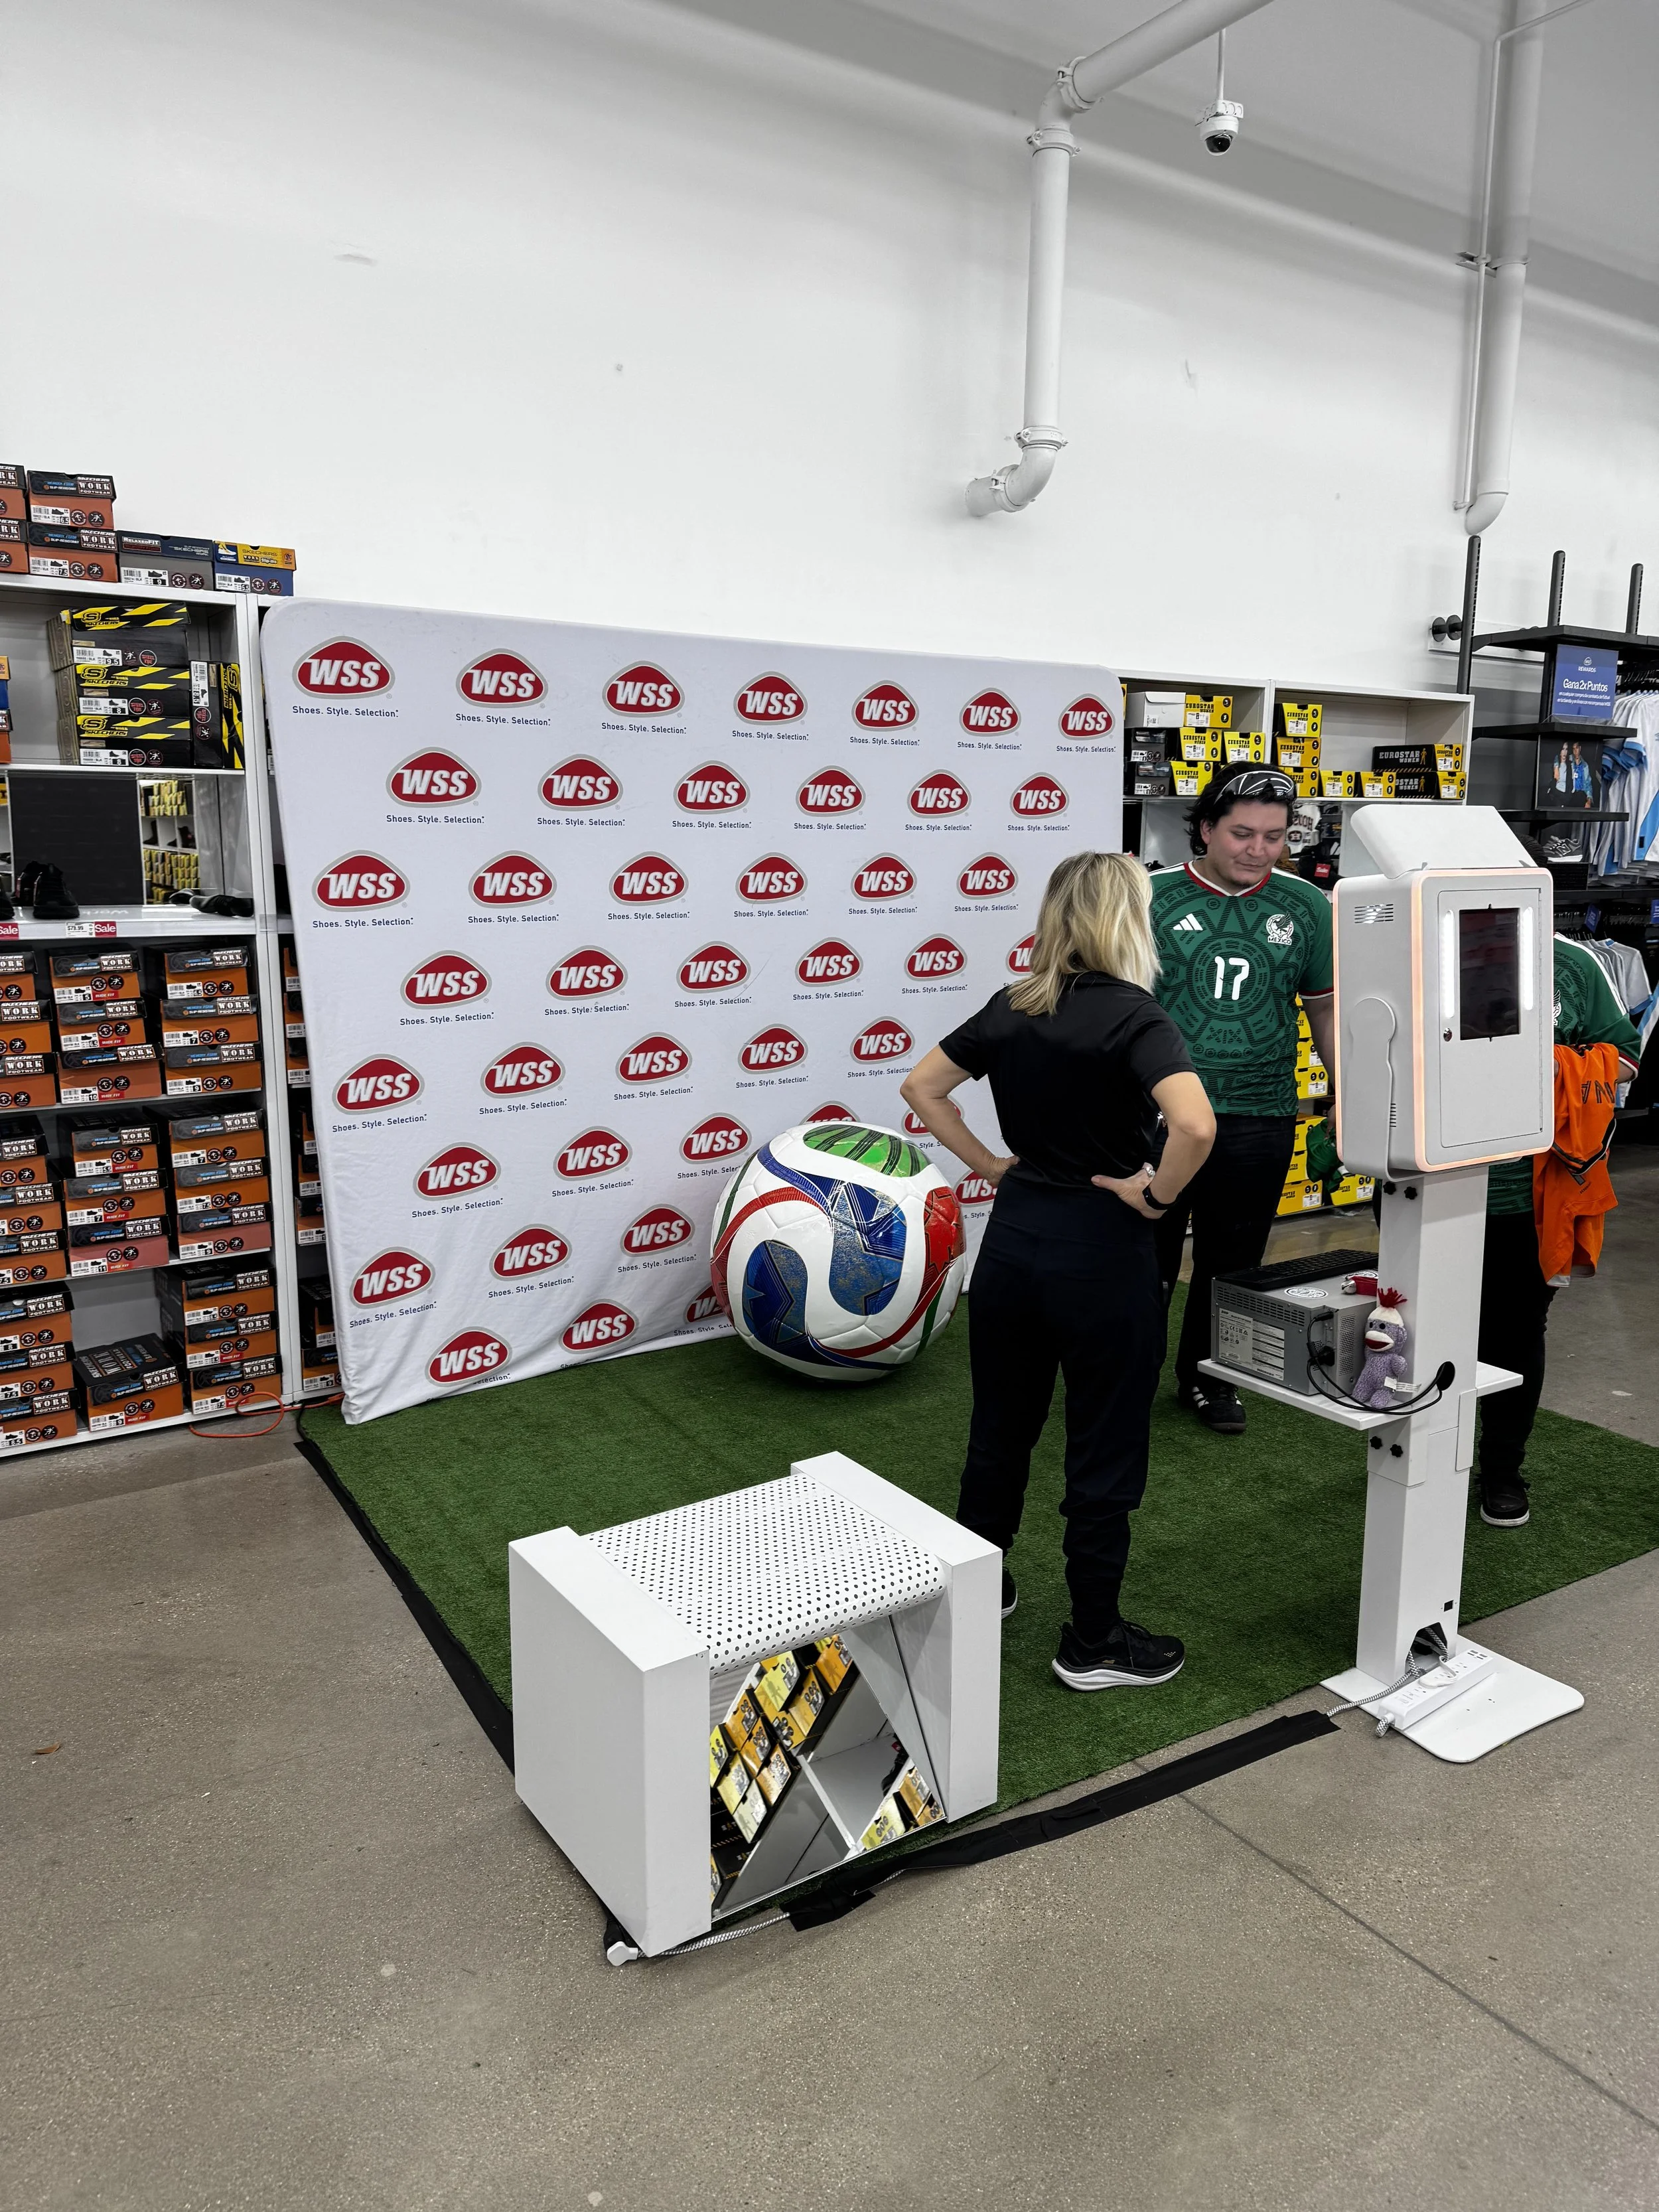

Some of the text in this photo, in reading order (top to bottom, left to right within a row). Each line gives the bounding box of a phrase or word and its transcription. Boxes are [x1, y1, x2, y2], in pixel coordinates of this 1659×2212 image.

[79, 482, 110, 490] WORK
[82, 536, 115, 544] WORK
[304, 658, 382, 688] WSS
[467, 668, 536, 698] WSS
[612, 680, 674, 708] WSS
[1563, 678, 1579, 690] Gana
[1587, 681, 1608, 692] Puntos
[292, 705, 323, 714] Shoes.
[326, 707, 351, 717] Style.
[743, 690, 798, 716] WSS
[861, 698, 911, 723] WSS
[455, 713, 483, 722] Shoes.
[486, 715, 509, 725] Style.
[967, 704, 1014, 728] WSS
[1065, 710, 1109, 732] WSS
[601, 722, 626, 731] Shoes.
[628, 724, 649, 733] Style.
[757, 731, 773, 740] Style.
[1379, 751, 1420, 759] EUROSTAR
[397, 769, 469, 796] WSS
[548, 774, 613, 801] WSS
[683, 779, 741, 804] WSS
[804, 784, 857, 808] WSS
[915, 786, 964, 809] WSS
[1017, 789, 1062, 810] WSS
[697, 821, 715, 830] Style.
[323, 872, 397, 899] WSS
[479, 871, 545, 897] WSS
[618, 871, 678, 895] WSS
[745, 871, 799, 894] WSS
[859, 869, 909, 892] WSS
[964, 869, 1011, 890] WSS
[344, 919, 369, 928] Style.
[685, 959, 742, 984] WSS
[804, 954, 855, 978] WSS
[912, 950, 960, 972] WSS
[412, 970, 480, 998] WSS
[556, 964, 617, 990] WSS
[1214, 956, 1250, 1000] 17
[430, 1015, 452, 1025] Style.
[747, 1040, 800, 1065] WSS
[858, 1031, 907, 1055] WSS
[7, 1060, 42, 1069] WORK
[491, 1059, 555, 1088] WSS
[625, 1049, 683, 1076] WSS
[343, 1072, 412, 1104] WSS
[226, 1117, 256, 1126] WORK
[332, 1124, 359, 1133] Shoes.
[362, 1120, 385, 1129] Style.
[3, 1144, 35, 1153] WORK
[689, 1128, 743, 1155] WSS
[563, 1142, 622, 1171] WSS
[125, 1176, 158, 1185] WORK
[424, 1159, 490, 1191] WSS
[17, 1189, 52, 1199] WORK
[963, 1177, 997, 1199] WS
[234, 1210, 264, 1218] WORK
[411, 1209, 439, 1218] Shoes.
[441, 1205, 462, 1214] Style.
[127, 1223, 161, 1232] WORK
[629, 1219, 685, 1248] WSS
[22, 1237, 57, 1248] WORK
[500, 1239, 562, 1272] WSS
[238, 1275, 269, 1286] WORK
[358, 1263, 424, 1298] WSS
[488, 1290, 514, 1298] Shoes.
[516, 1284, 536, 1293] Style.
[27, 1294, 62, 1303] SKECHERS
[29, 1299, 63, 1311] WORK
[569, 1313, 628, 1345] WSS
[31, 1350, 64, 1361] WORK
[435, 1341, 500, 1377] WSS
[143, 1366, 177, 1377] SKECHERS
[145, 1371, 177, 1384] WORK
[244, 1363, 275, 1374] WORK
[33, 1392, 69, 1400] SKECHERS
[35, 1397, 68, 1408] WORK
